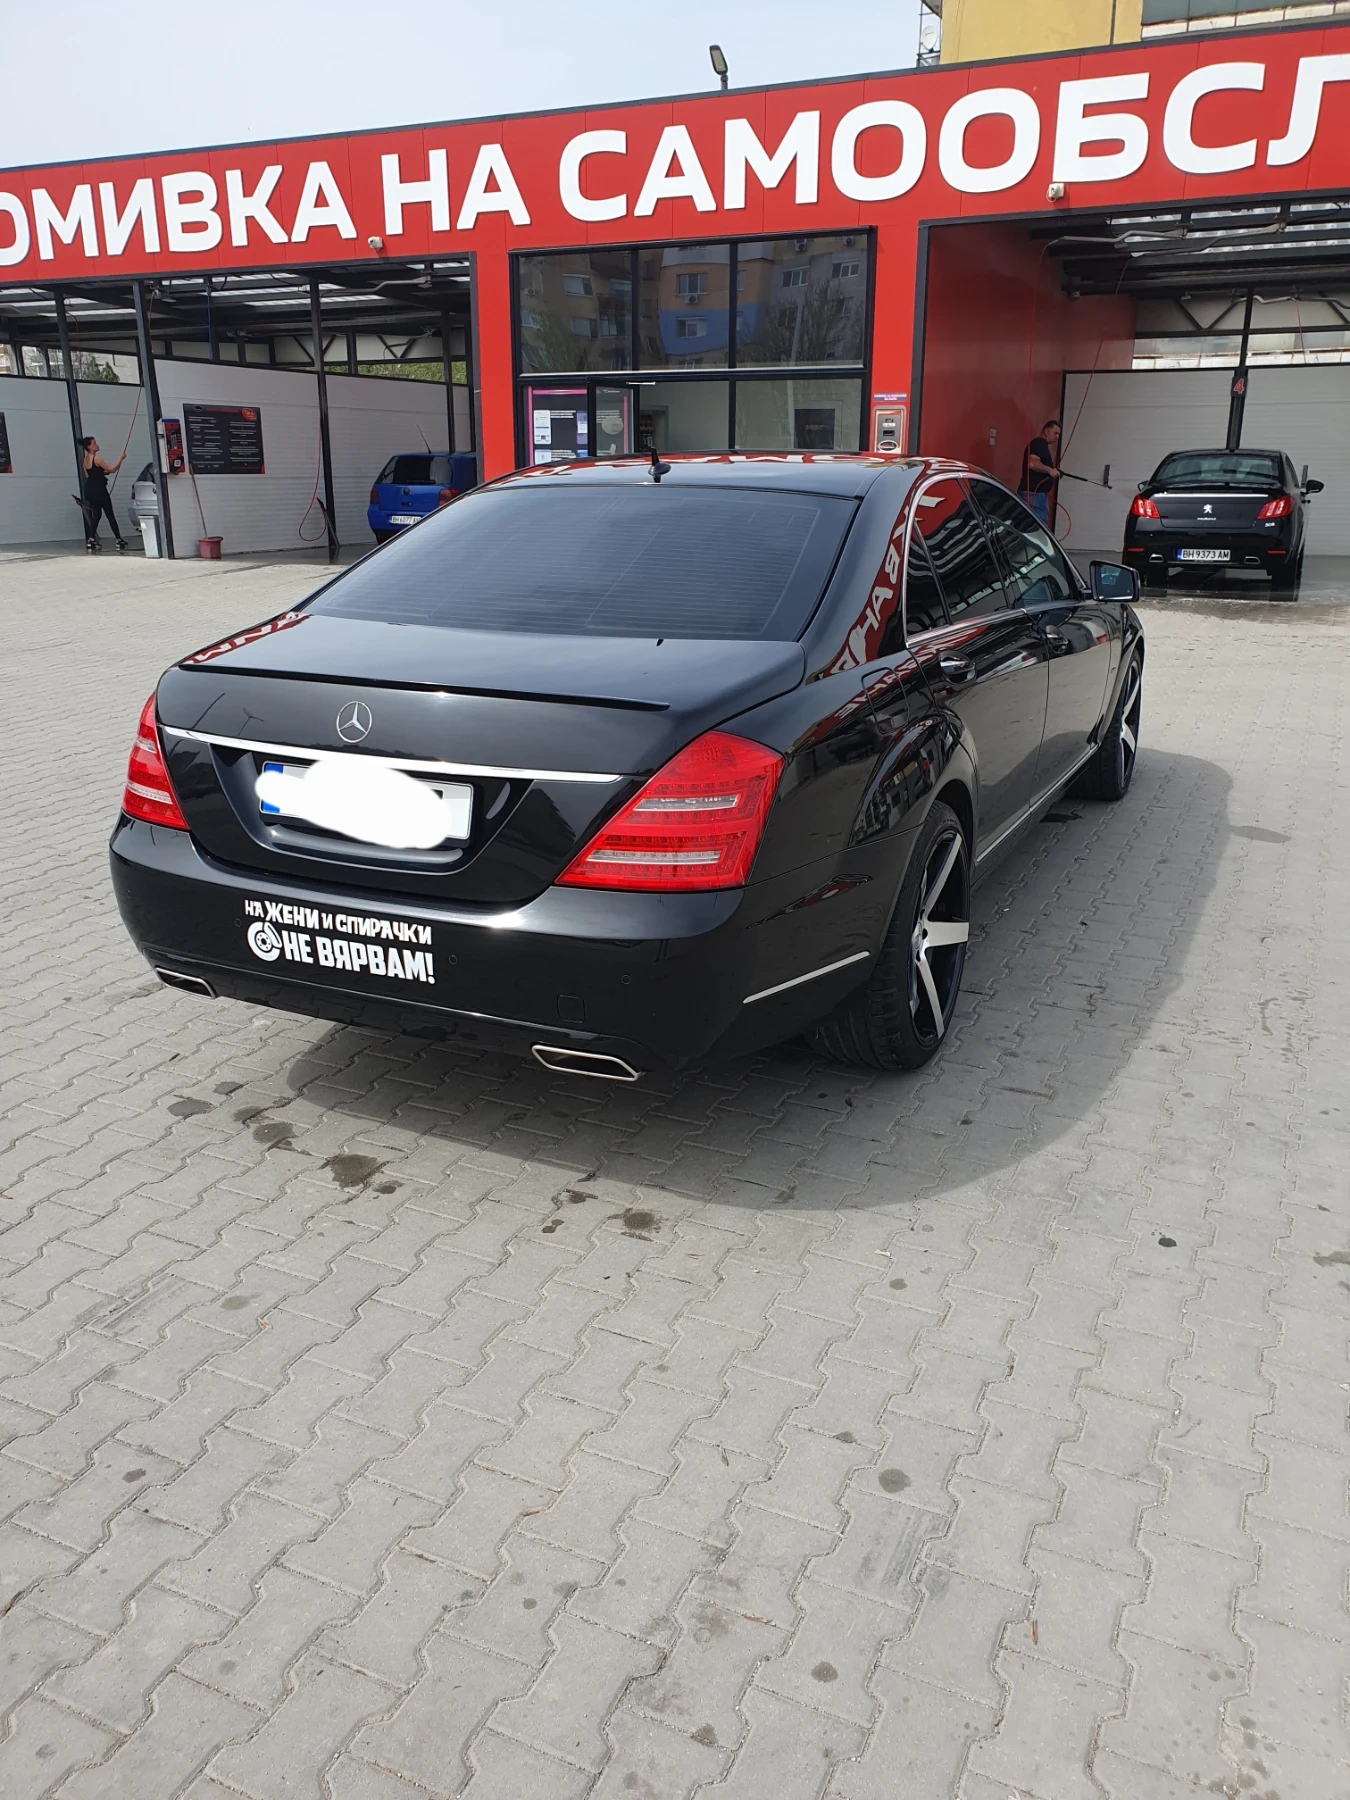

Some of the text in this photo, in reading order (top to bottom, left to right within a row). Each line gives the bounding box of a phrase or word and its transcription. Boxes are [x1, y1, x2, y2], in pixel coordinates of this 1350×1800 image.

[382, 143, 531, 235] НА
[1233, 378, 1245, 395] 4
[1195, 550, 1216, 559] 9373
[244, 900, 264, 918] НА
[264, 900, 320, 930] ЖЕНИ
[335, 913, 432, 945] СПИРАЧКИ
[281, 930, 436, 985] НЕ ВЯРВАМ!
